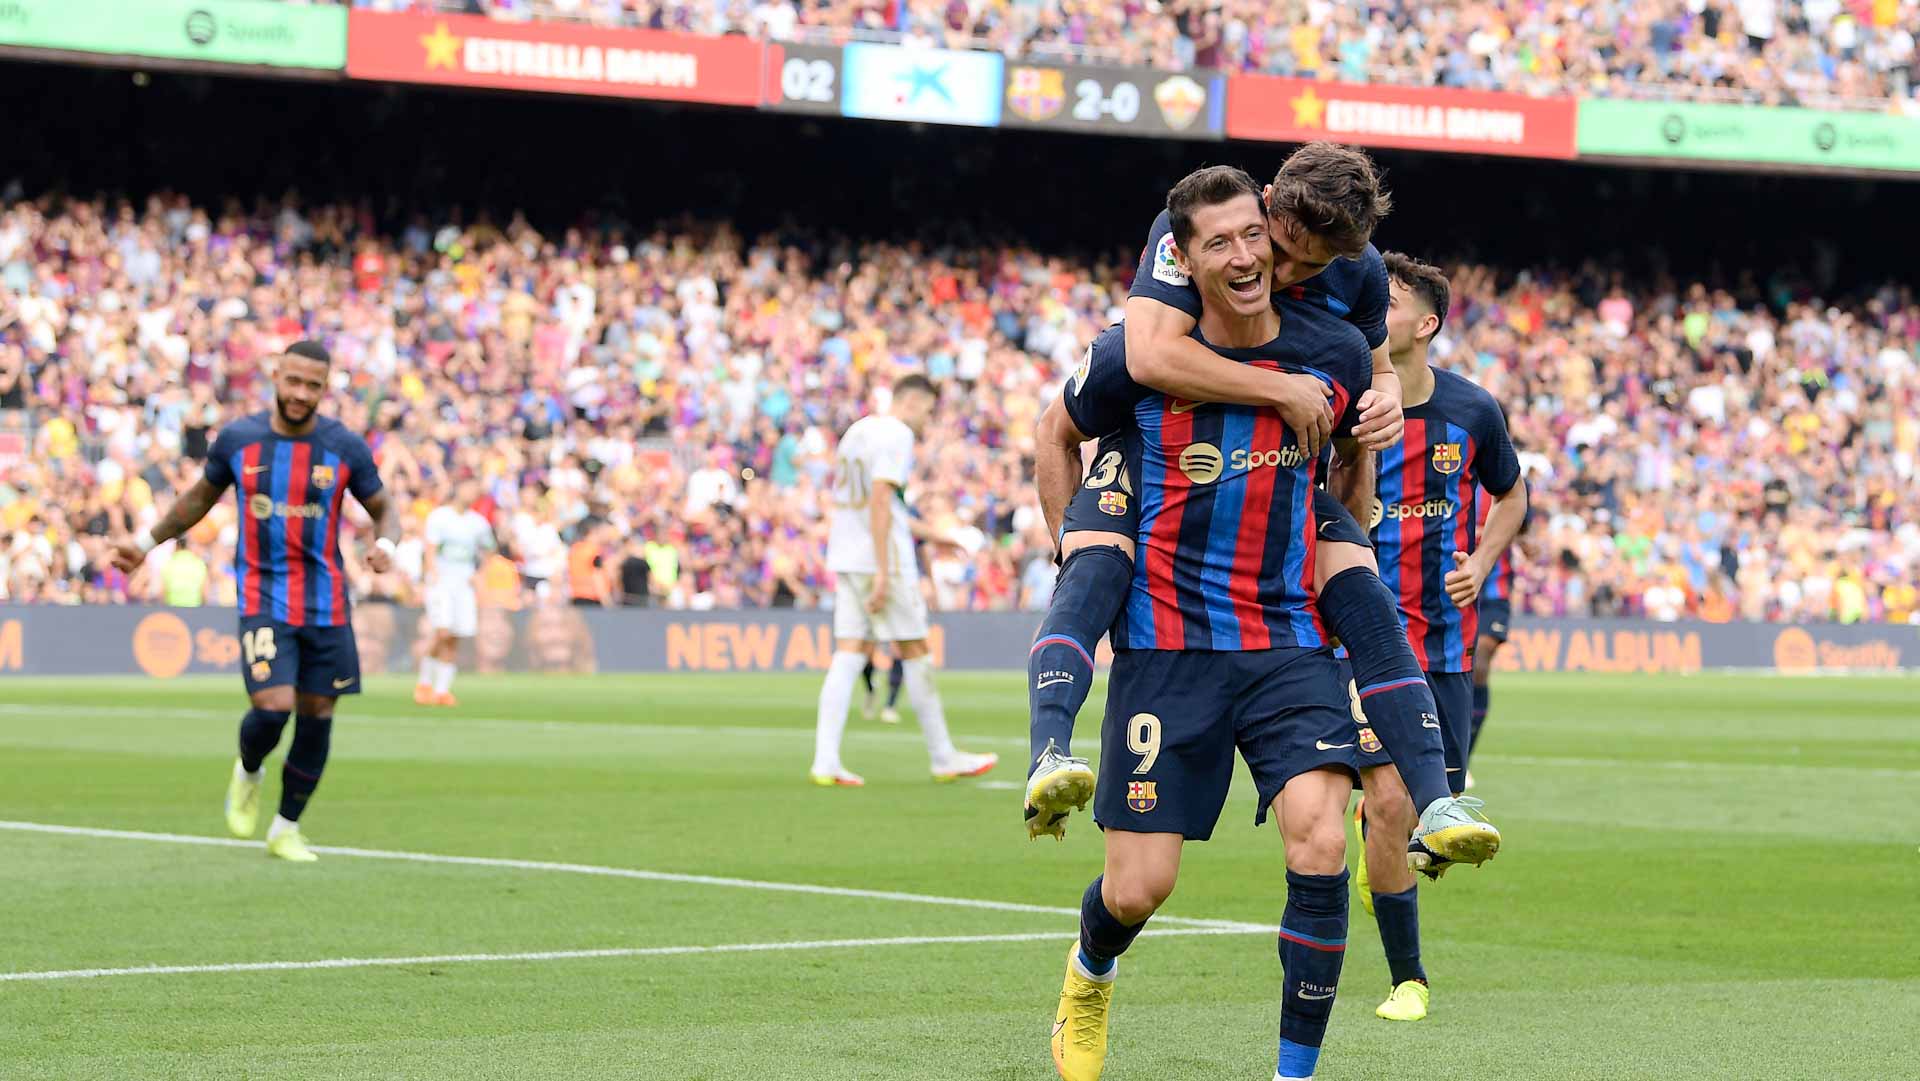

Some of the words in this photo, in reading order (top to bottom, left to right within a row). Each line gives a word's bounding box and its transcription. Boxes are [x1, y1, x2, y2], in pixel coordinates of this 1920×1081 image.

[464, 37, 603, 80] ESTRELLA
[605, 48, 698, 88] DAMM
[783, 58, 836, 102] 02
[1073, 79, 1141, 123] 2-0
[1326, 99, 1444, 139] ESTRELLA
[1446, 107, 1525, 145] DAMM
[834, 457, 868, 511] 20
[1386, 500, 1456, 521] Spotify
[243, 627, 277, 664] 14
[666, 623, 780, 671] NEW
[1565, 629, 1702, 674] ALBUM
[1127, 713, 1162, 775] 9
